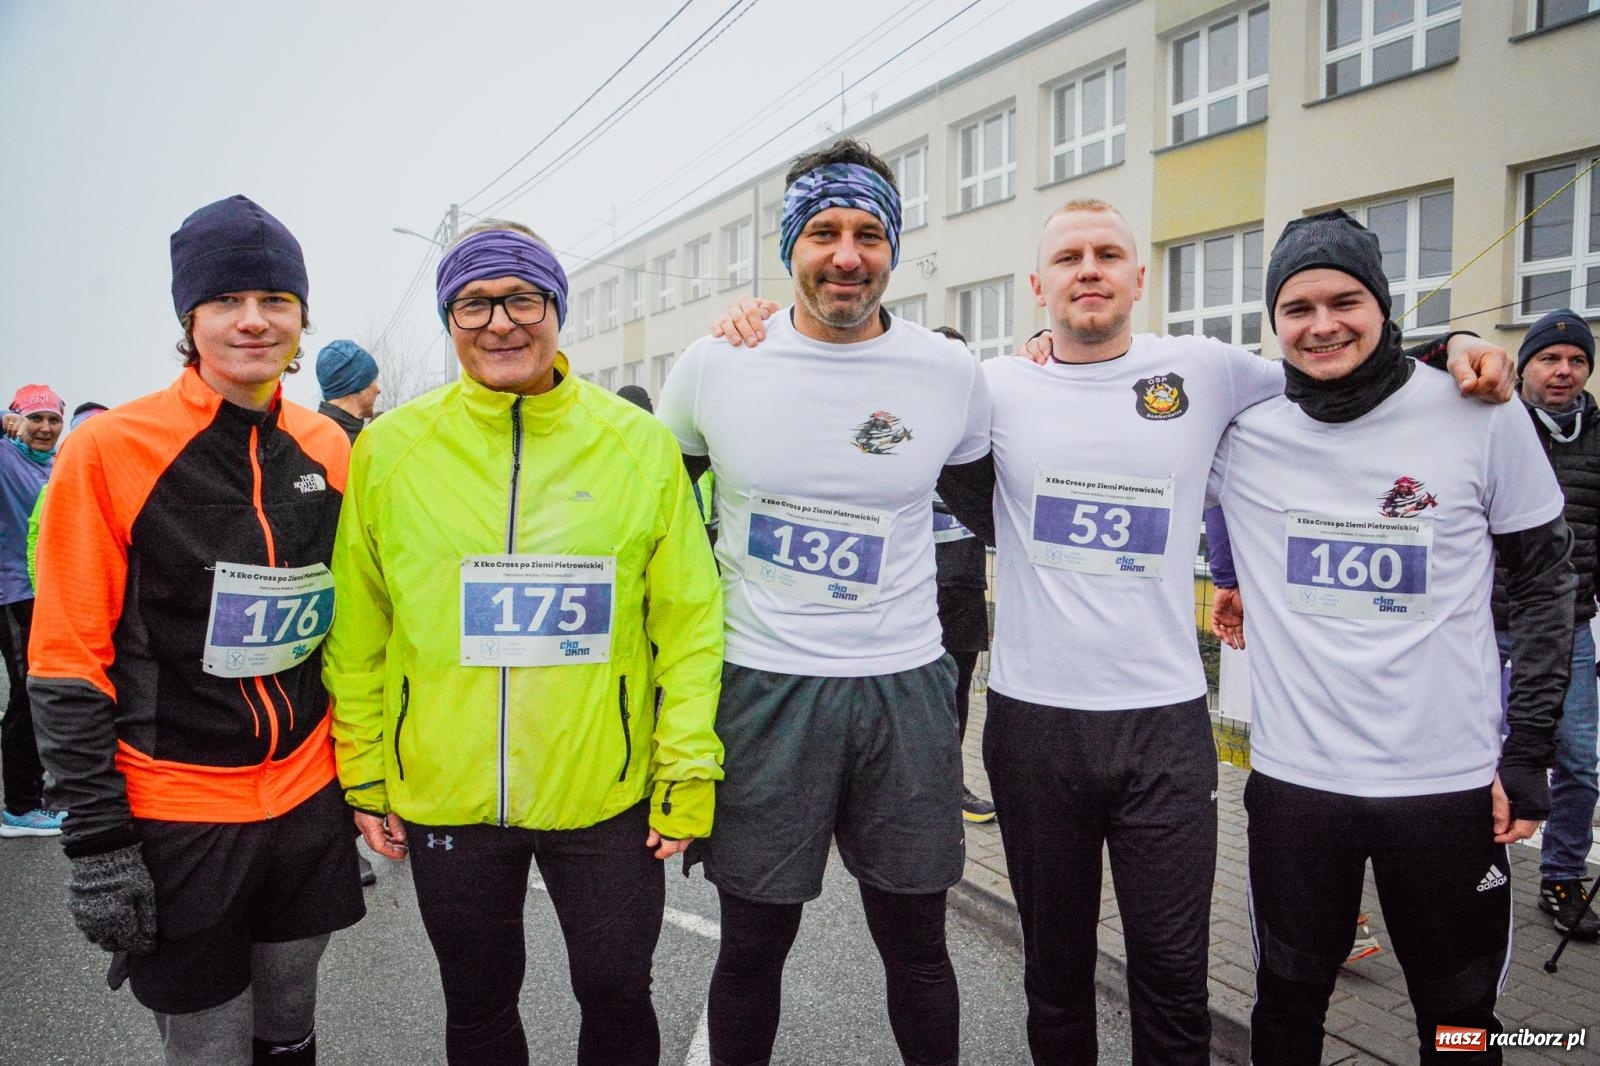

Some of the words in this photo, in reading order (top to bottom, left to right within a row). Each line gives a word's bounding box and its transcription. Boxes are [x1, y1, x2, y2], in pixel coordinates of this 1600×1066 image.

[1065, 479, 1086, 487] Cross
[1097, 482, 1118, 490] Ziemi
[1118, 485, 1164, 496] Pietrowickiej
[781, 501, 801, 511] Cross
[812, 507, 833, 515] Ziemi
[834, 510, 880, 524] Pietrowickiej
[1068, 503, 1131, 548] 53
[1345, 521, 1366, 529] Ziemi
[1367, 523, 1419, 533] Pietrowickiej
[773, 525, 860, 577] 136
[237, 572, 252, 580] Eko
[254, 572, 277, 581] Cross
[288, 574, 304, 582] Ziemi
[555, 561, 604, 570] Pietrowickiej
[1311, 543, 1403, 589] 160
[242, 594, 320, 643] 176
[491, 587, 587, 632] 175
[1477, 876, 1507, 891] adidas
